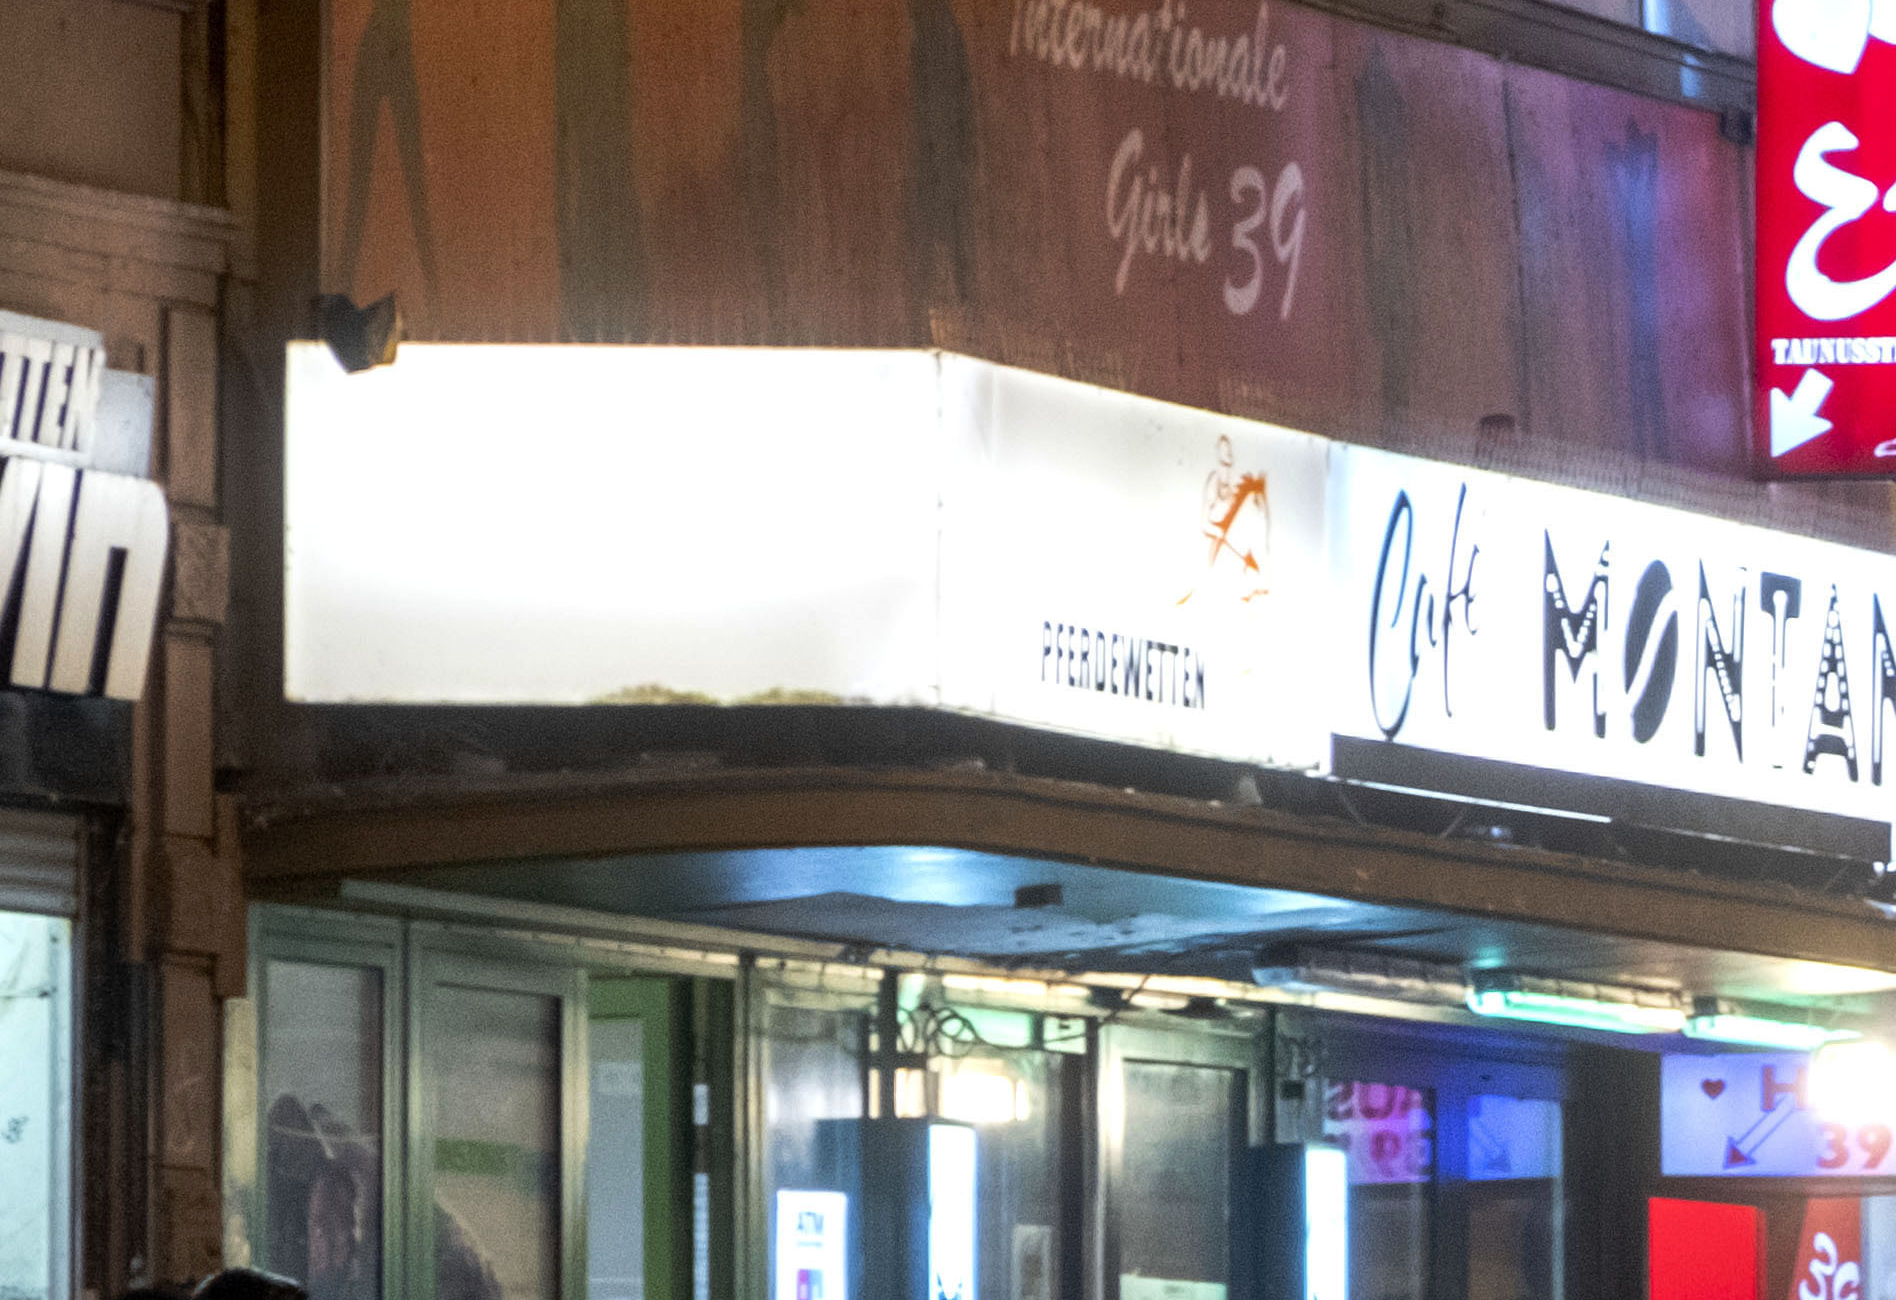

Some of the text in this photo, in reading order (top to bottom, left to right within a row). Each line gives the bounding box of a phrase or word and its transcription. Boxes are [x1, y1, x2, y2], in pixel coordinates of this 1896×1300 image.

[1106, 128, 1306, 322] Girls 39
[1041, 621, 1206, 710] PFERDEWETTEN
[1820, 1122, 1894, 1170] 39
